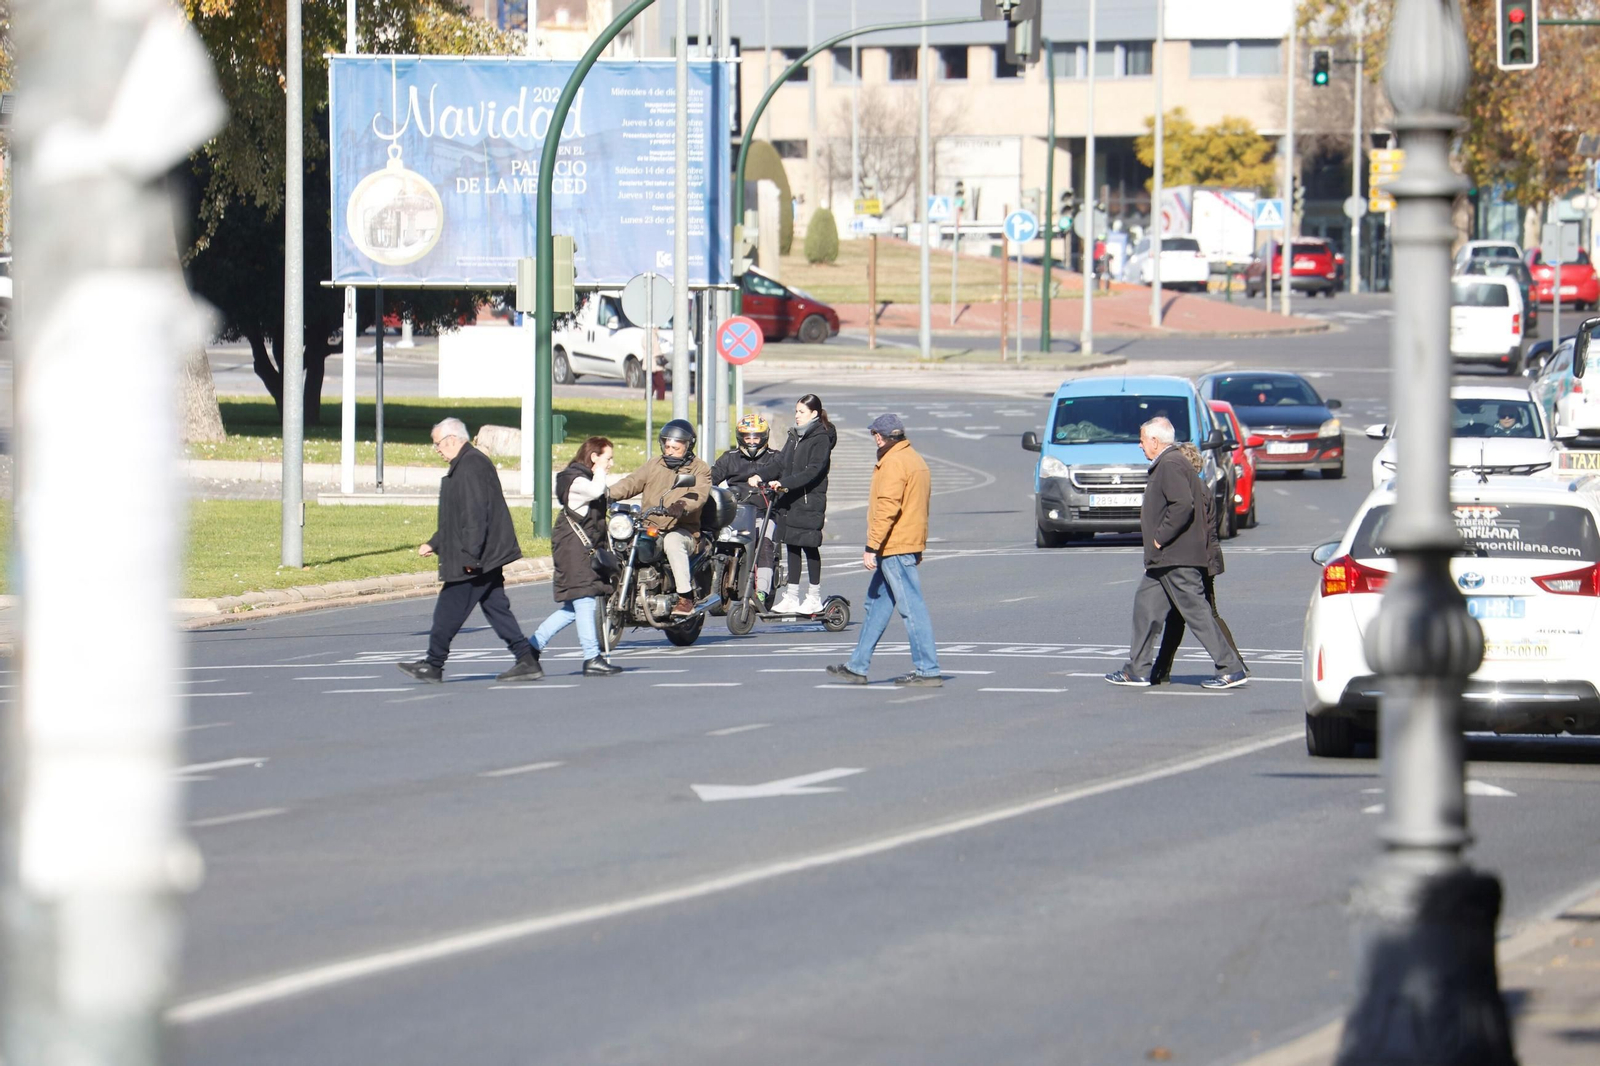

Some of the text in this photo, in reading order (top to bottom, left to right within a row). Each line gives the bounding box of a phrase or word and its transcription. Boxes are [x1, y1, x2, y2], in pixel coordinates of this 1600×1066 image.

[533, 87, 562, 103] 202
[372, 83, 586, 140] Navidad
[621, 118, 647, 127] Jueves
[558, 146, 585, 156] EN EL
[511, 160, 587, 176] PALCIO
[614, 166, 643, 175] Sábado
[456, 177, 587, 194] DE LA MECED
[617, 191, 643, 200] Jueves
[620, 216, 643, 224] Lunes
[1570, 453, 1600, 469] TAXI
[1455, 519, 1498, 527] TABERNA
